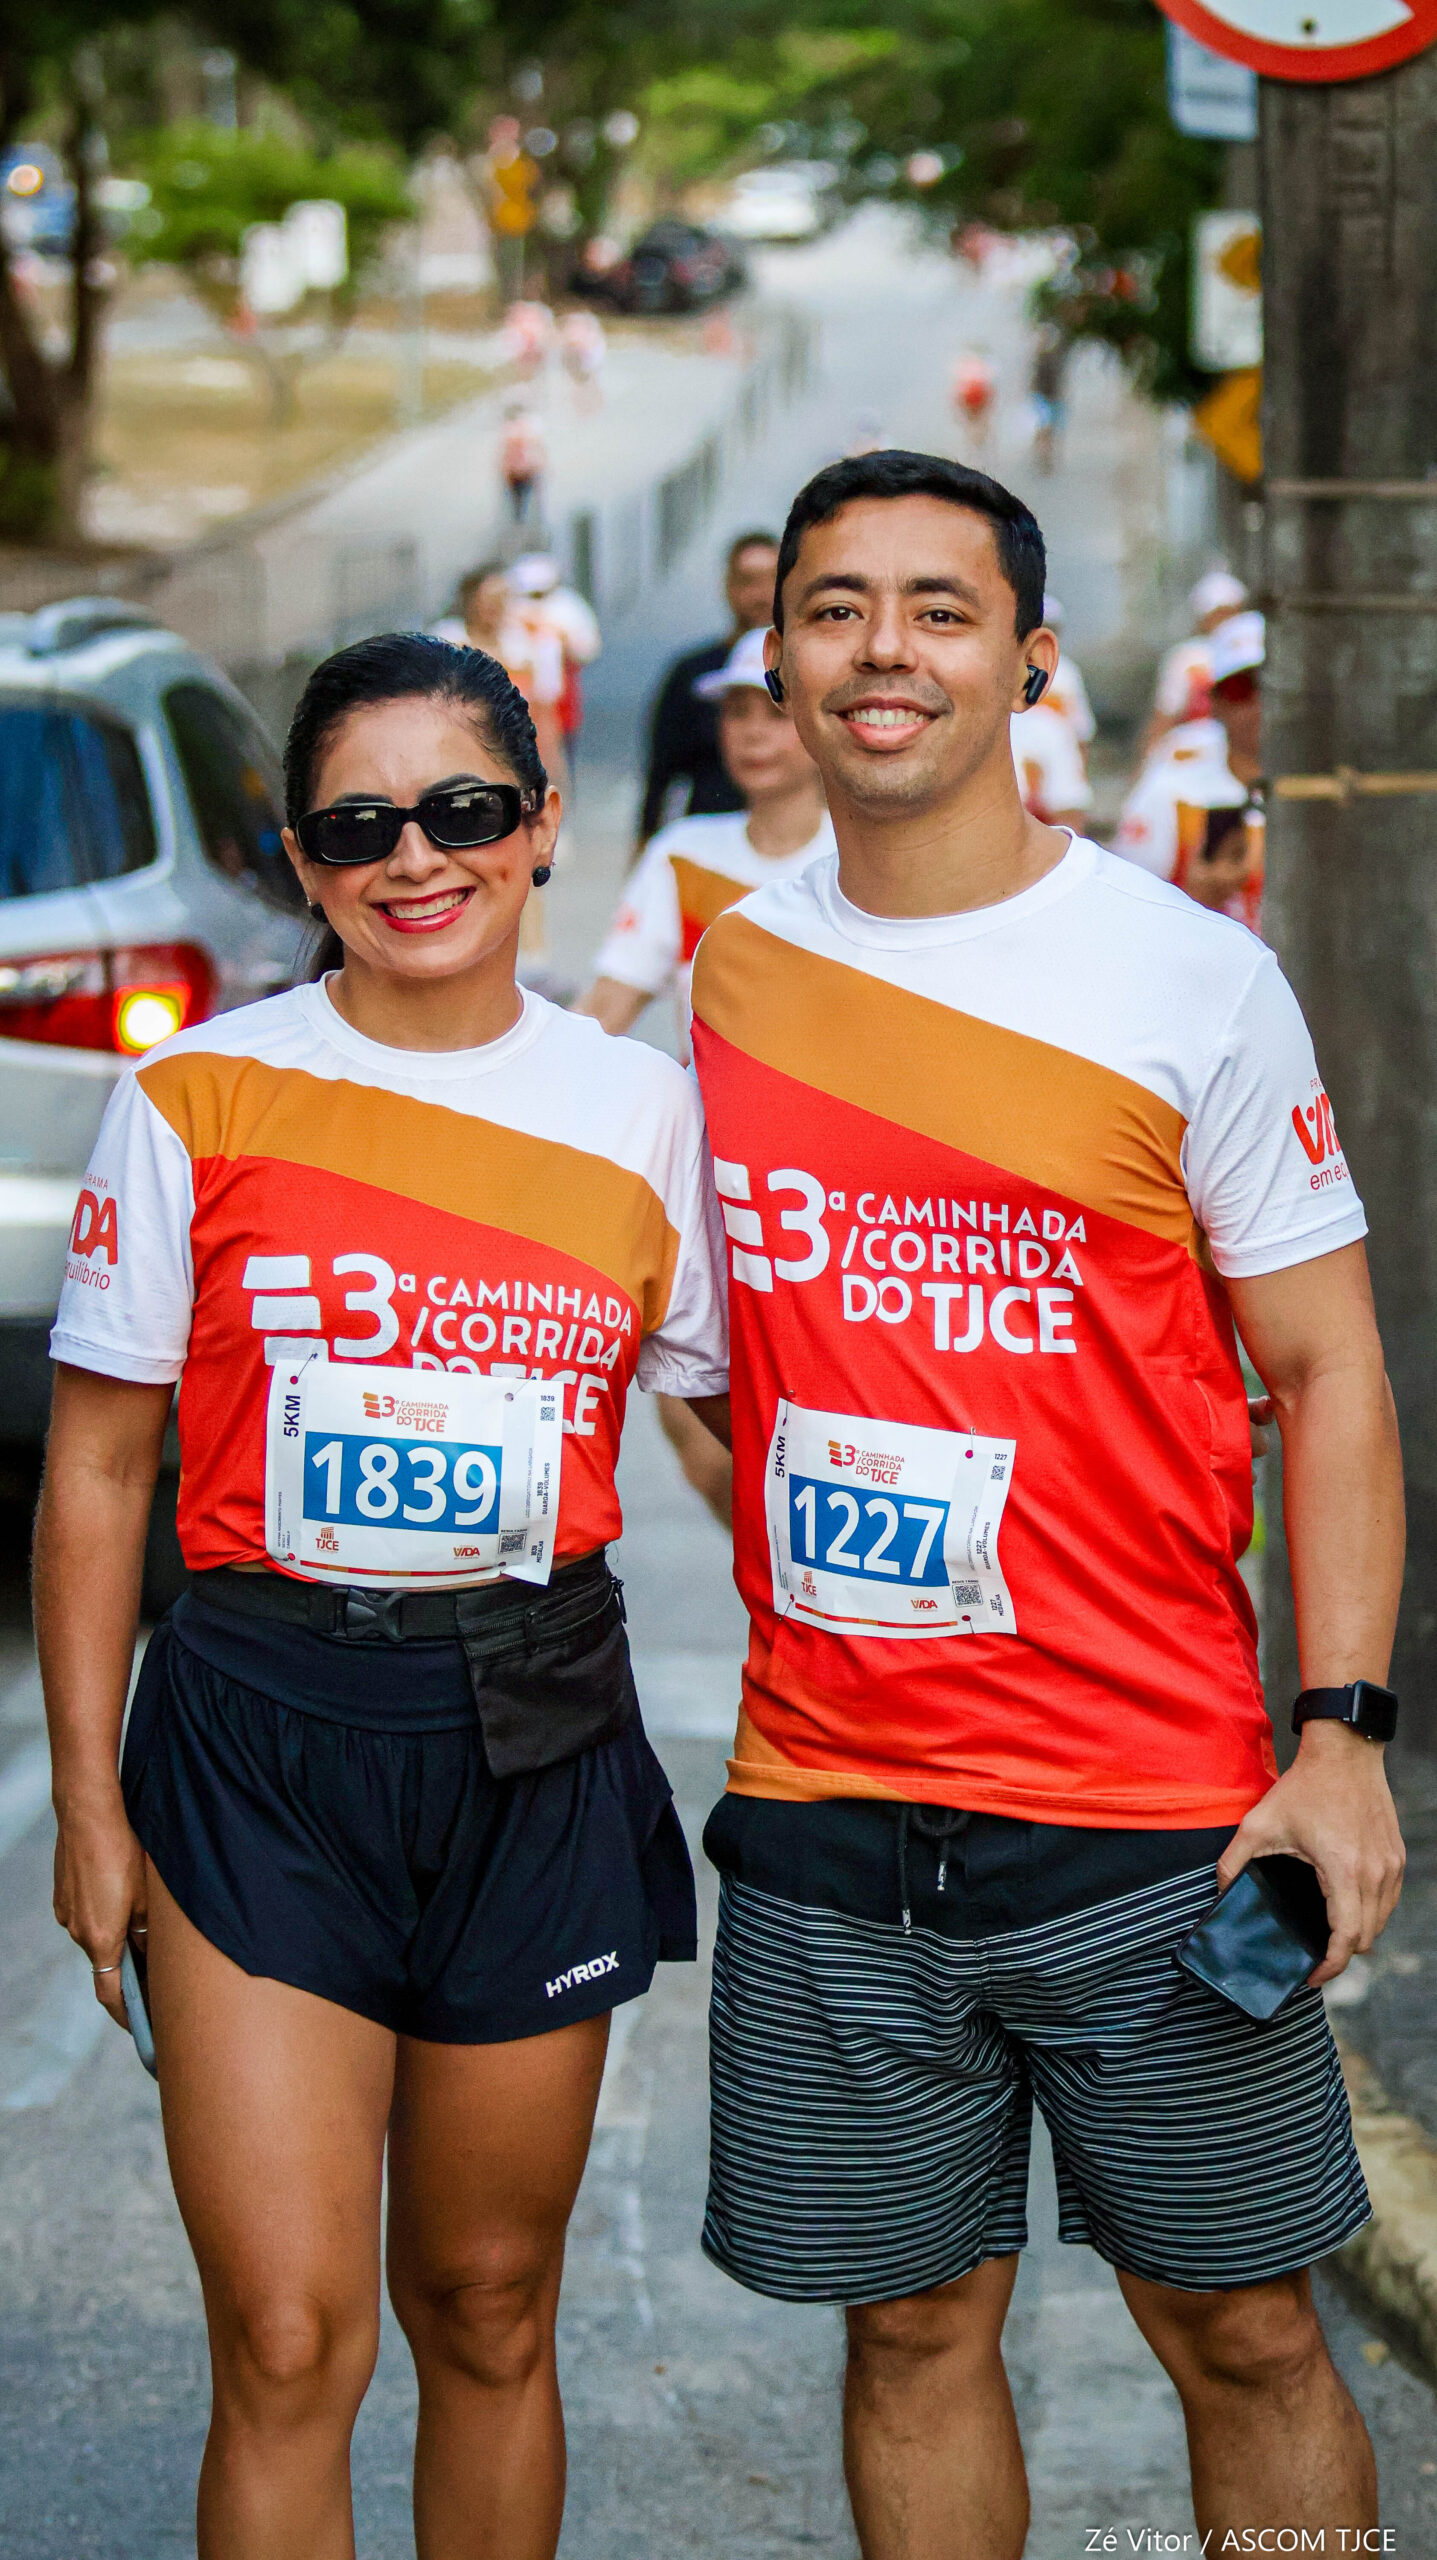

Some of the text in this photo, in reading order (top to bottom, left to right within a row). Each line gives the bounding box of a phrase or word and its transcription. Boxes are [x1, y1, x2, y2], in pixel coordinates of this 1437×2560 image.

[1310, 1168, 1334, 1190] em
[856, 1193, 1087, 1243] CAMINHADA
[841, 1225, 1084, 1286] /CORRIDA
[427, 1276, 632, 1337] CAMINHADA
[842, 1274, 1077, 1353] DO TJCE
[411, 1307, 621, 1371] /CORRIDA
[284, 1395, 300, 1437] 5KM
[397, 1406, 447, 1418] /CORRIDA
[401, 1400, 449, 1410] CAMINHADA
[396, 1415, 445, 1432] DO TJCE
[775, 1435, 786, 1478] 5KM
[857, 1456, 902, 1471] /CORRIDA
[861, 1450, 905, 1463] CAMINHADA
[994, 1453, 1008, 1461] 1227
[311, 1440, 497, 1526] 1839
[855, 1465, 899, 1485] DO TJCE
[794, 1484, 946, 1579] 1227
[315, 1537, 340, 1551] TJCE
[453, 1546, 480, 1557] VIDA
[910, 1599, 938, 1609] VIDA
[545, 1951, 620, 1998] HYROX
